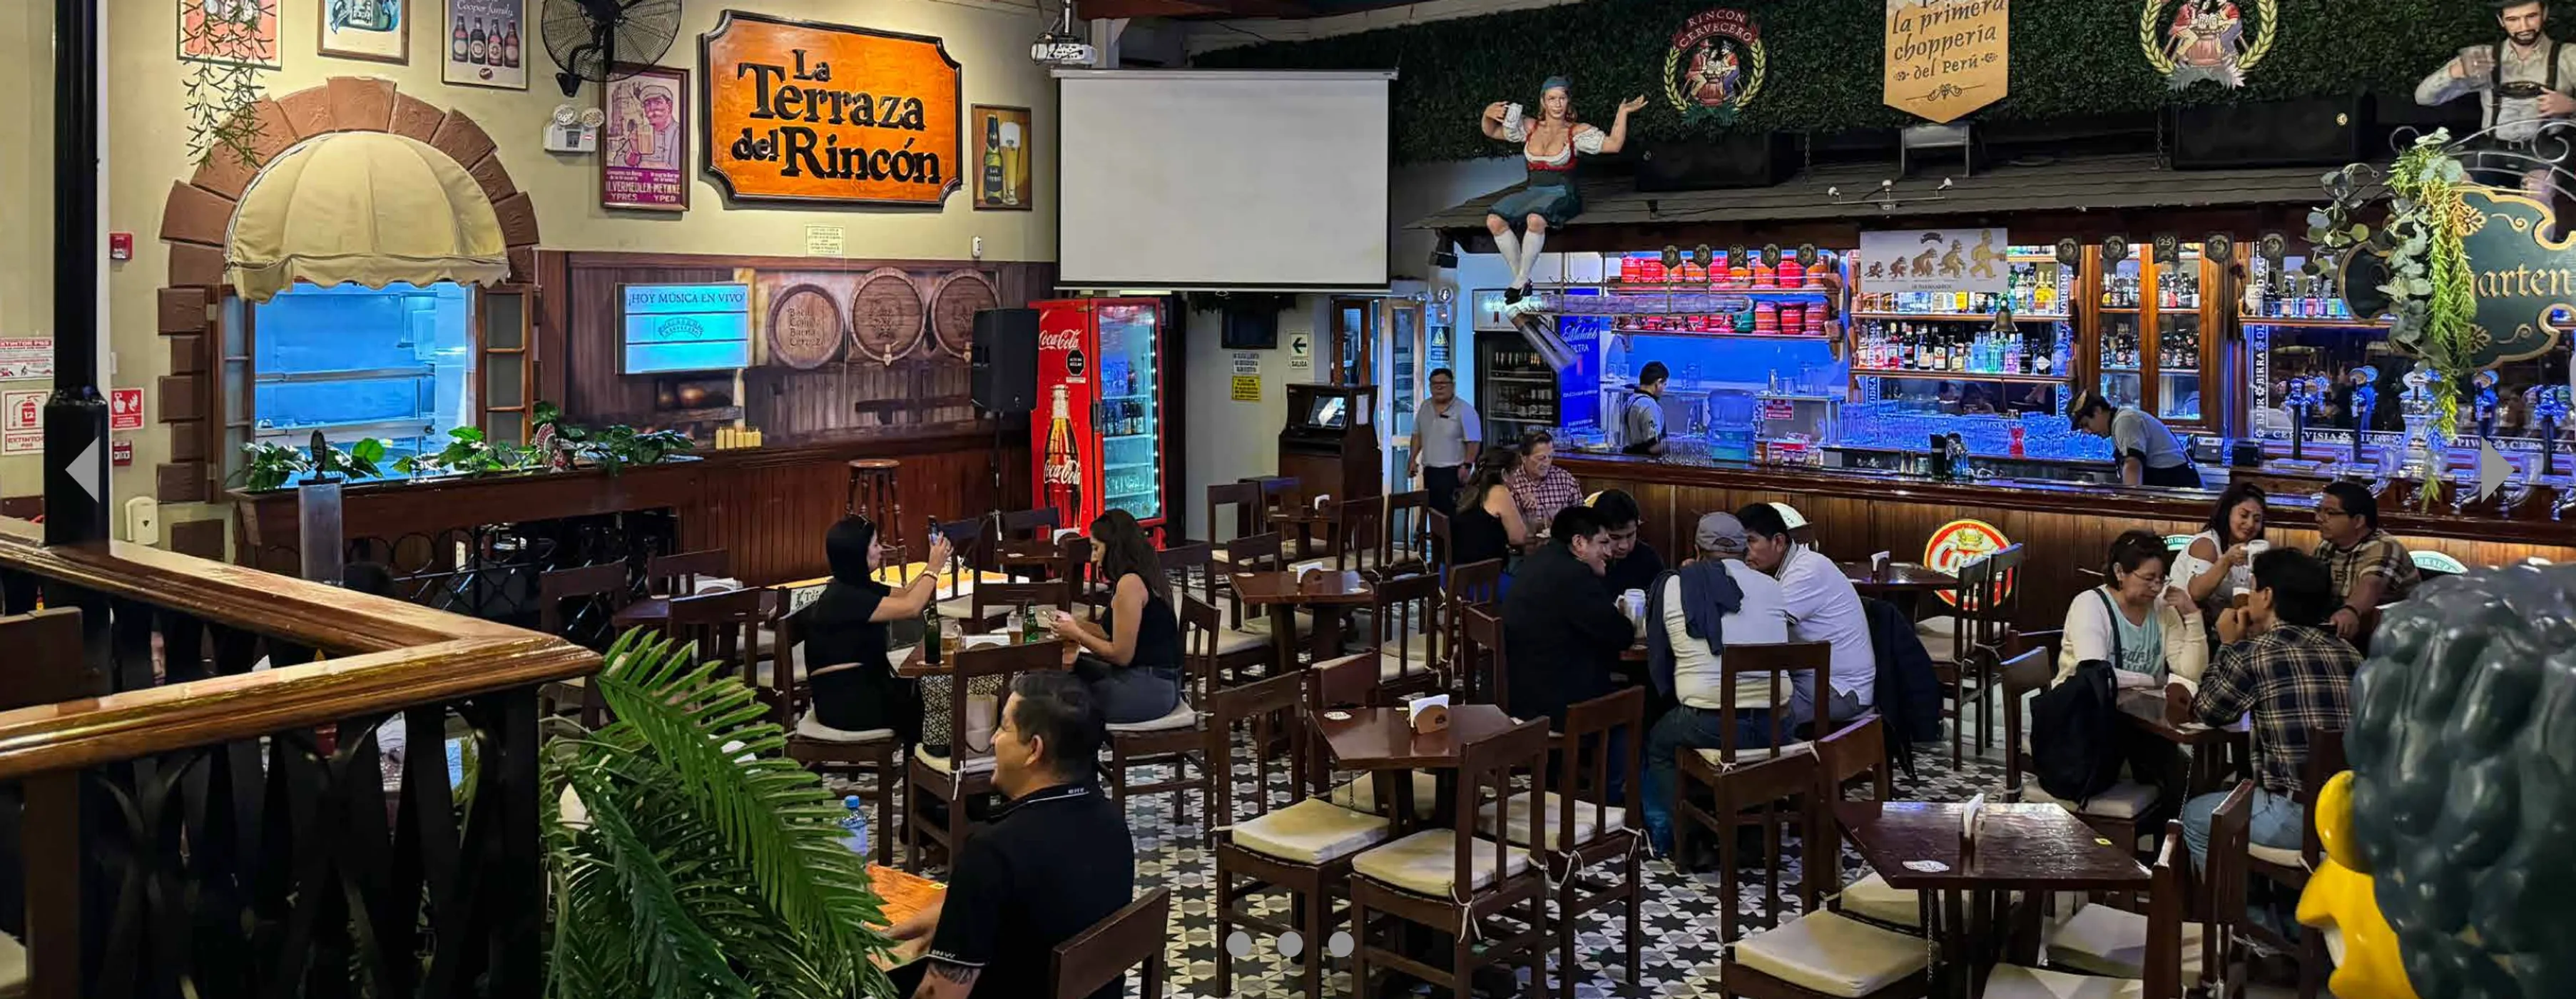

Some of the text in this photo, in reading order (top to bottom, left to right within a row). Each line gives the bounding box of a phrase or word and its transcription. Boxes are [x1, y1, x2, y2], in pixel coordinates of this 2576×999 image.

[1688, 9, 1745, 26] RINCON
[1893, 0, 2005, 34] la primera
[1679, 23, 1753, 47] CERVECERO
[792, 49, 831, 81] La
[1914, 54, 1978, 80] del Perú
[737, 62, 927, 131] Terraza
[730, 126, 942, 184] del Rincón
[2060, 266, 2069, 314] OURBON
[2470, 263, 2572, 298] arten
[701, 293, 716, 303] EN
[1039, 329, 1083, 350] Coca-Cola
[2256, 352, 2265, 385] BIRRA
[2273, 430, 2337, 440] CERVISIA
[1044, 460, 1081, 485] Coca-Cola
